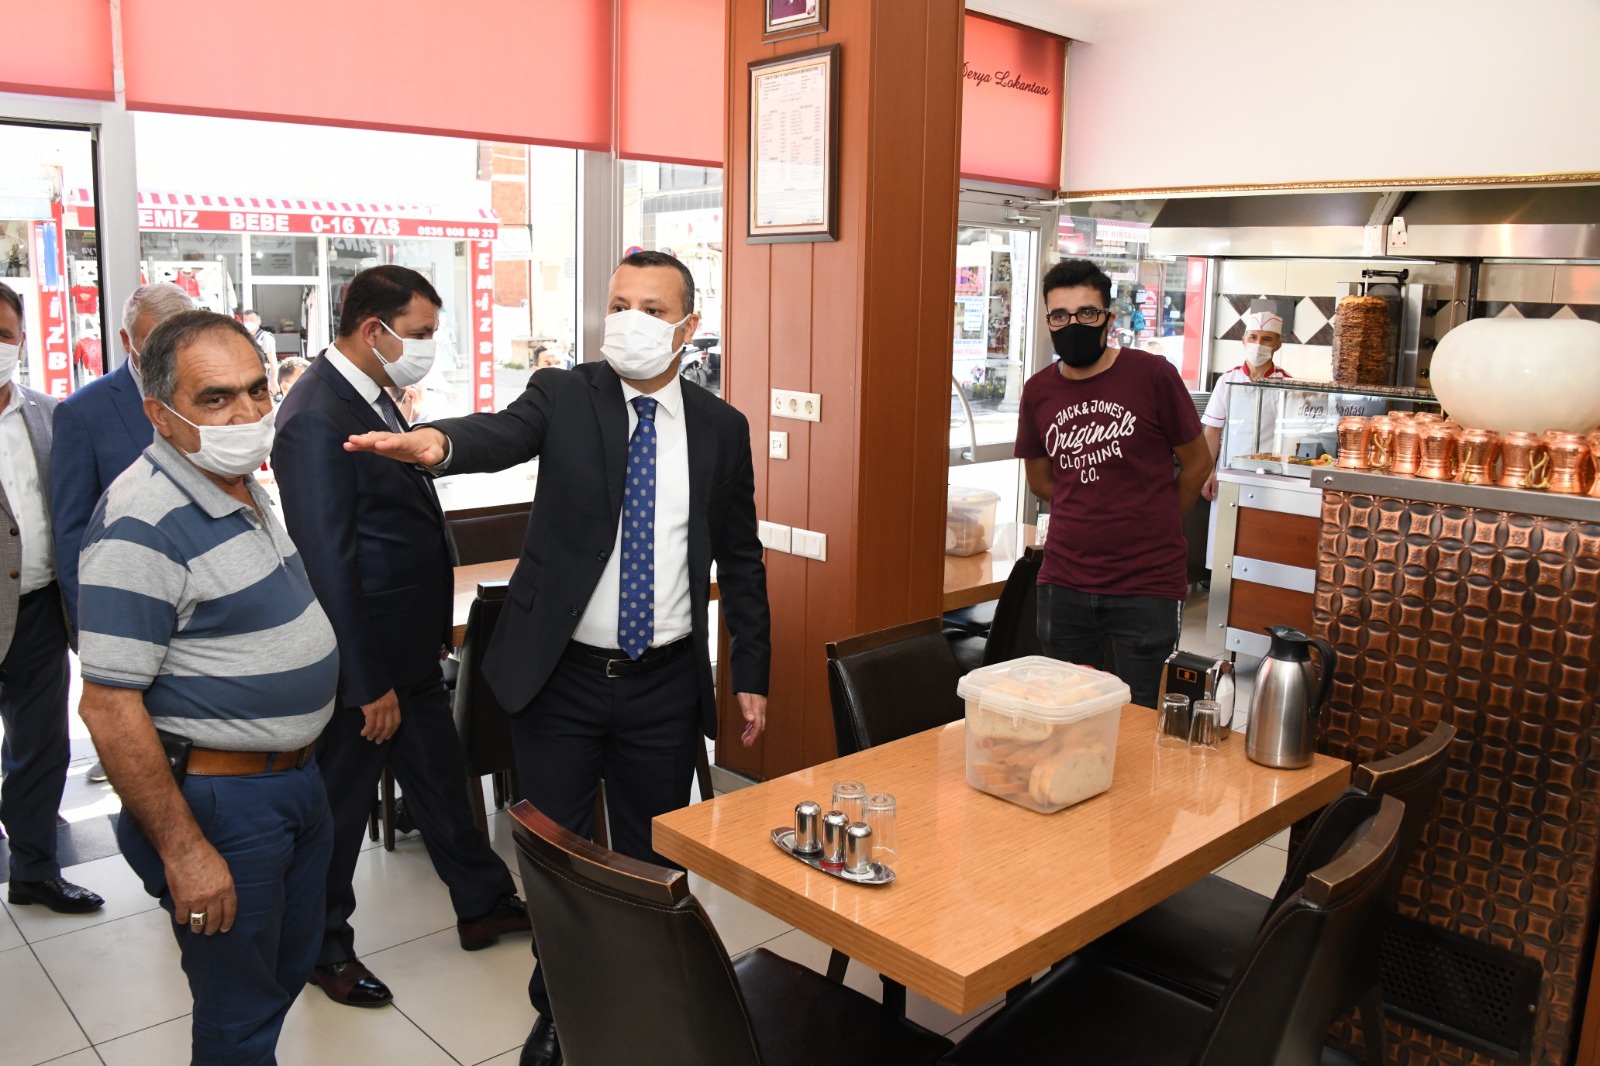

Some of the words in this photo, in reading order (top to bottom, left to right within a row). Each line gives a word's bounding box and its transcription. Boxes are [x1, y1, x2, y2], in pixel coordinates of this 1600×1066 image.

[994, 71, 1051, 96] Lokantası
[138, 207, 199, 229] EMİZ
[229, 213, 290, 232] BEBE
[310, 216, 355, 234] 0-16
[1045, 411, 1137, 457] Originals
[1060, 440, 1123, 469] CLOTHING
[1081, 467, 1100, 484] CO.
